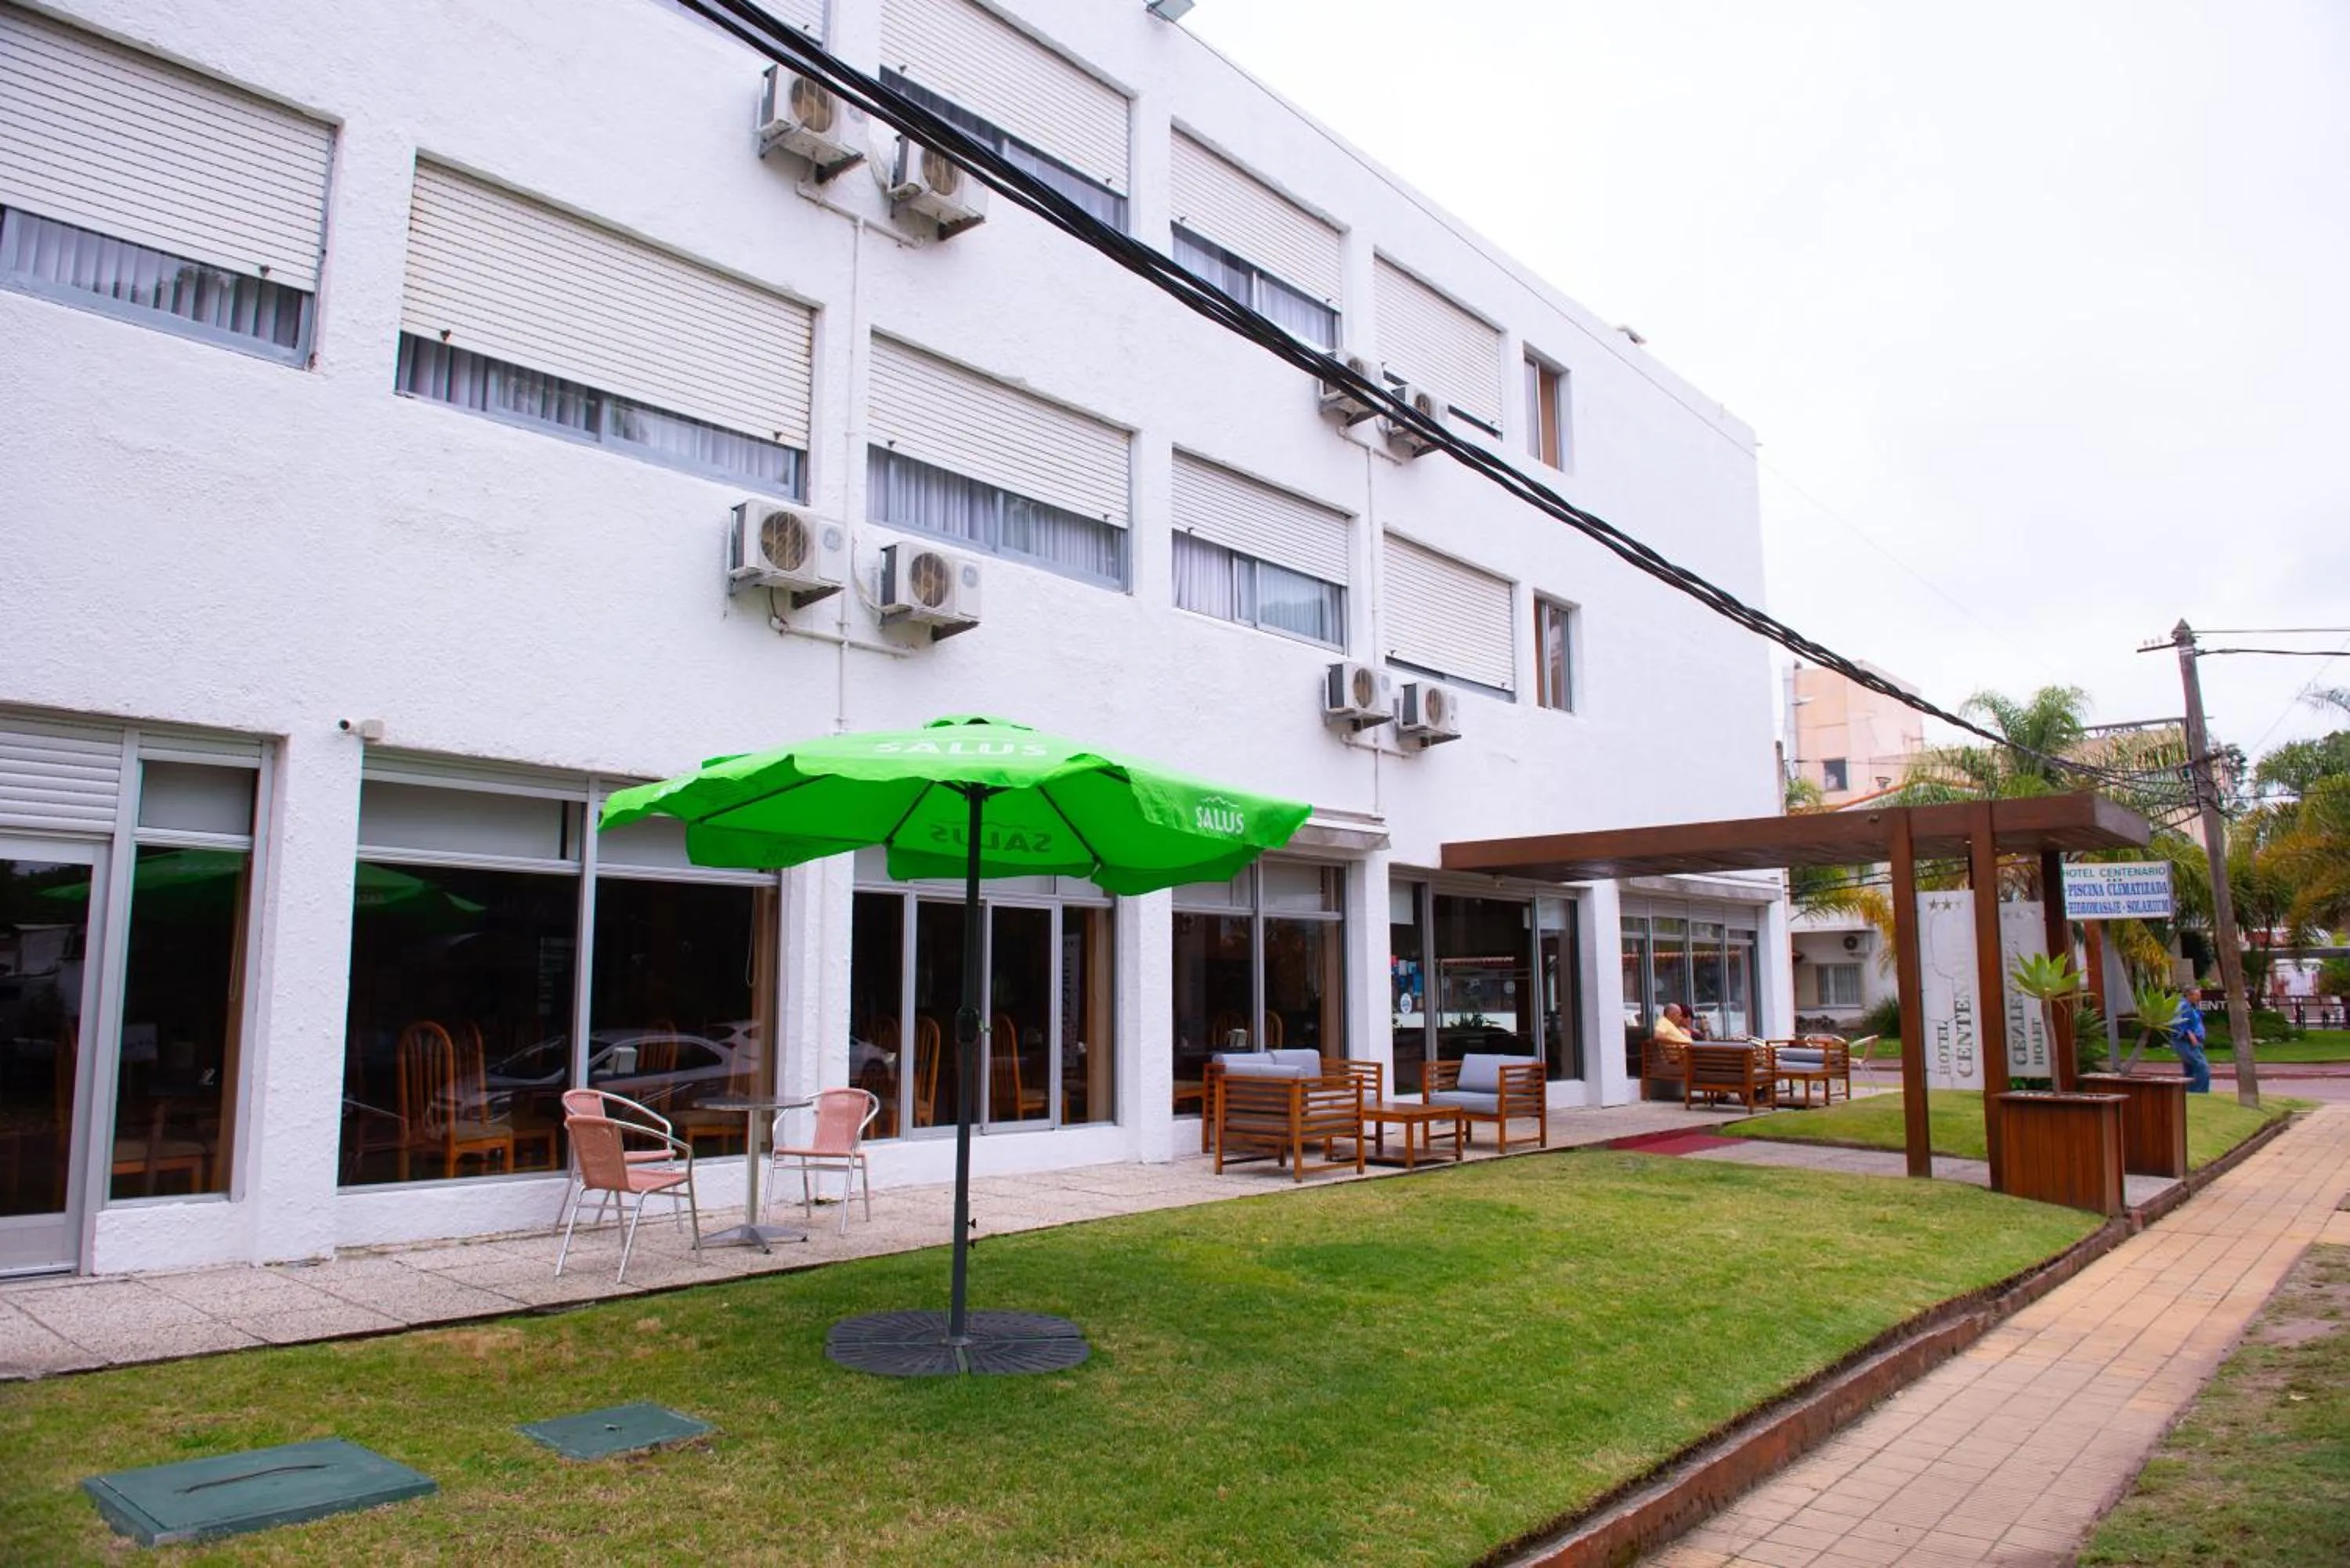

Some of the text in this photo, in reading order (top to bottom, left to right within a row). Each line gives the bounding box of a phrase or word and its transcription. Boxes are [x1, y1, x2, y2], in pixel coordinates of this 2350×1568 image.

[874, 741, 1047, 757] SALUS
[1195, 806, 1244, 834] SALUS
[2064, 866, 2166, 878] HOTEL CENTENARIO
[2068, 881, 2168, 897] PISCINA CLIMATIZADA
[2068, 901, 2121, 914] HIDROMASAJE
[2127, 899, 2169, 913] SOLARIUM
[1937, 1020, 1950, 1076] HOTEL
